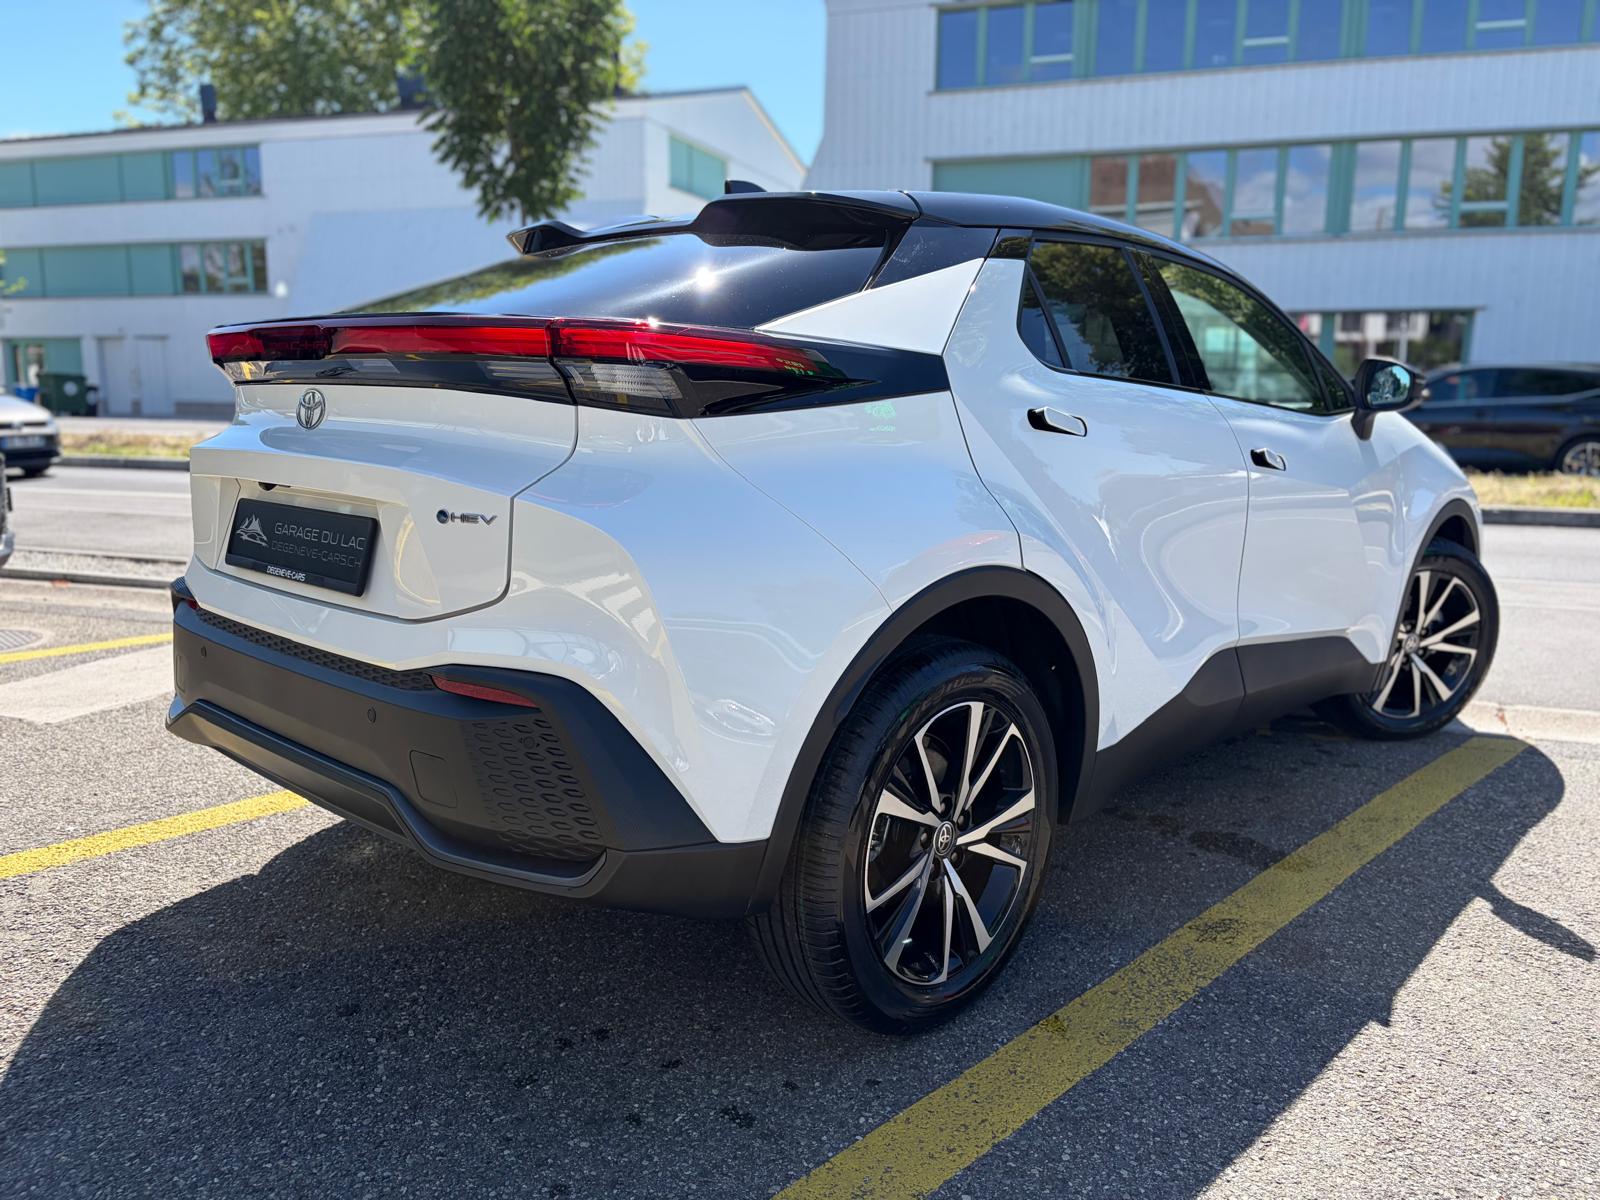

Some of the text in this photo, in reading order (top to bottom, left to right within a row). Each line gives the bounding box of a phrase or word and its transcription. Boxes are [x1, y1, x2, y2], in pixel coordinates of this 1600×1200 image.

[450, 511, 498, 525] HEV
[274, 522, 366, 550] GARAGE DU LAC
